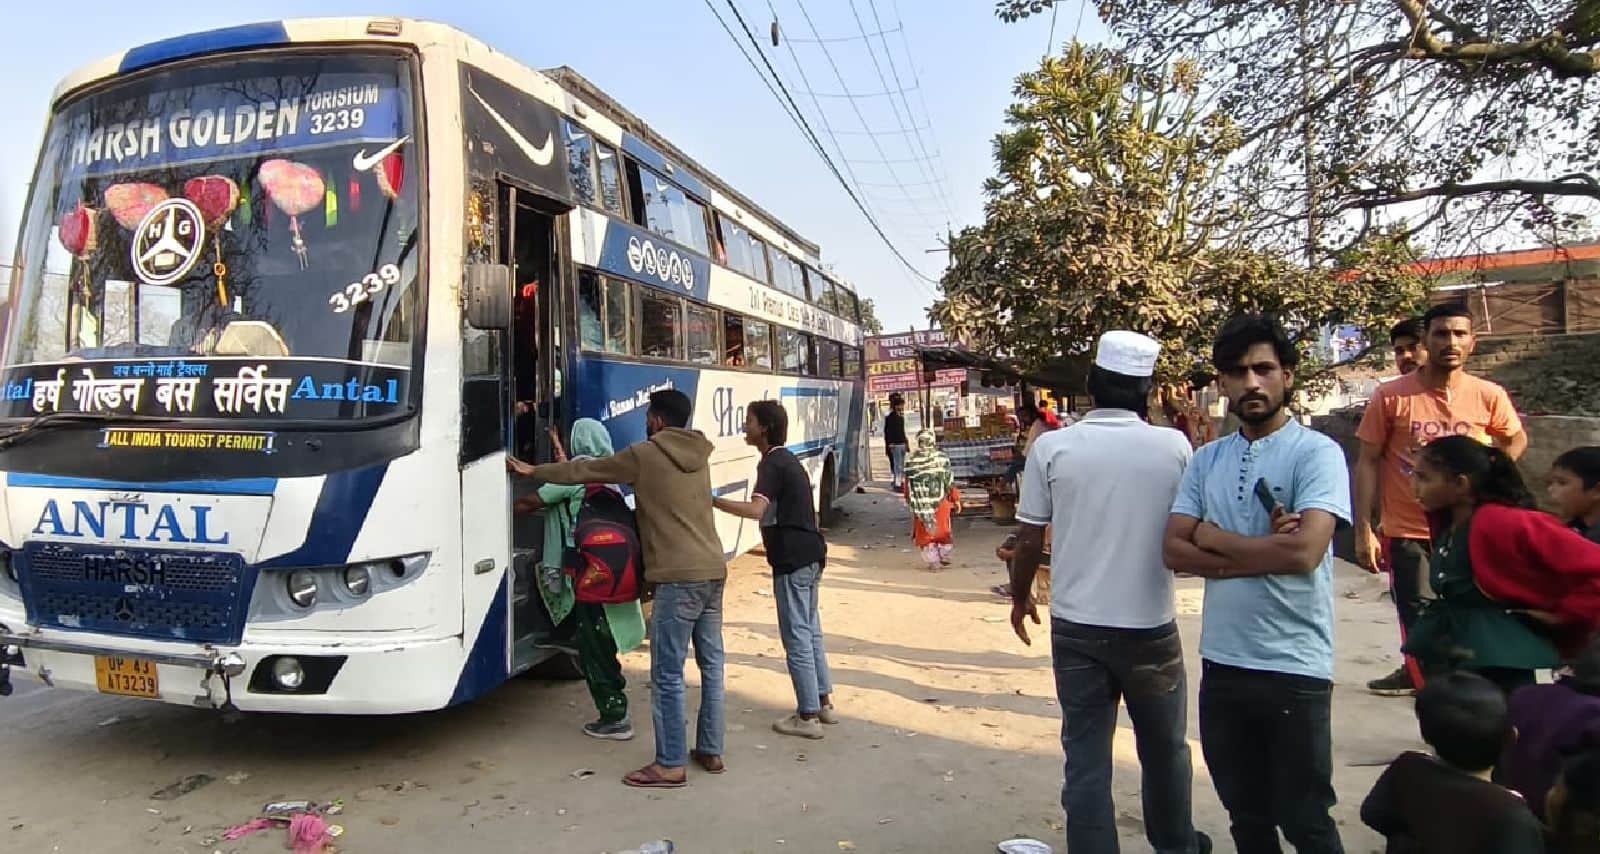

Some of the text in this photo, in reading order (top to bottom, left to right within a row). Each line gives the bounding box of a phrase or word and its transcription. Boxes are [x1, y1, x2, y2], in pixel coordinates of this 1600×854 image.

[169, 97, 299, 150] GOLDEN
[310, 108, 364, 135] 3239
[328, 263, 400, 313] 3239
[33, 364, 292, 414] हर्ष गोल्डन बस सर्विस
[291, 376, 398, 403] Antal
[110, 432, 265, 450] ALL INDIA TOURIST PERMIT
[31, 498, 229, 545] ANTAL
[84, 556, 166, 584] HARSH
[108, 673, 155, 693] AT3239
